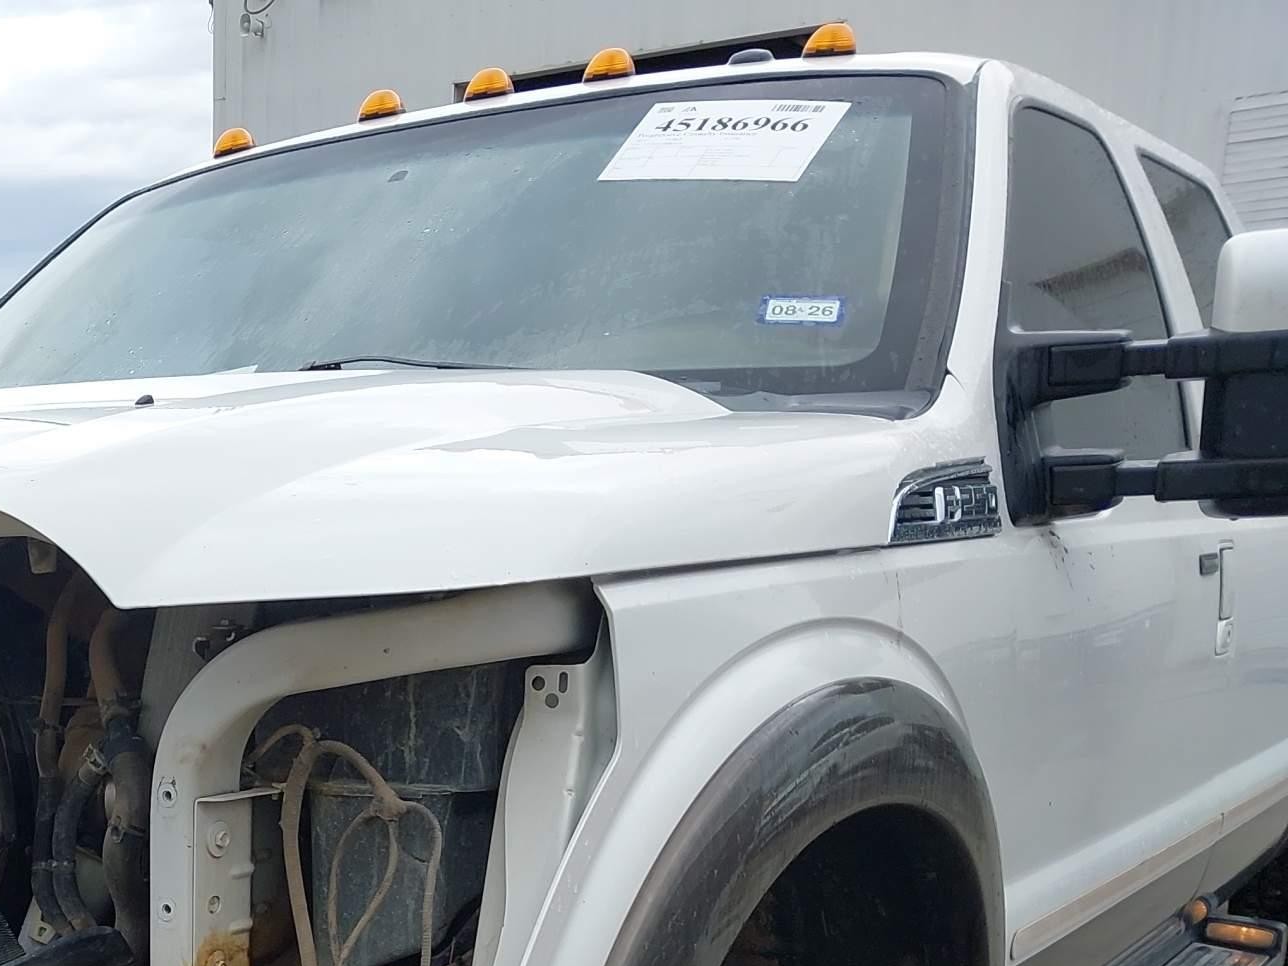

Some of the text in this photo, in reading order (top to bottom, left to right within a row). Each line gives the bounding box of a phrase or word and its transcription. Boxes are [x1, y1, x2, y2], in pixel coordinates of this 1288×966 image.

[655, 116, 812, 133] 45186966
[772, 305, 834, 317] 08 26
